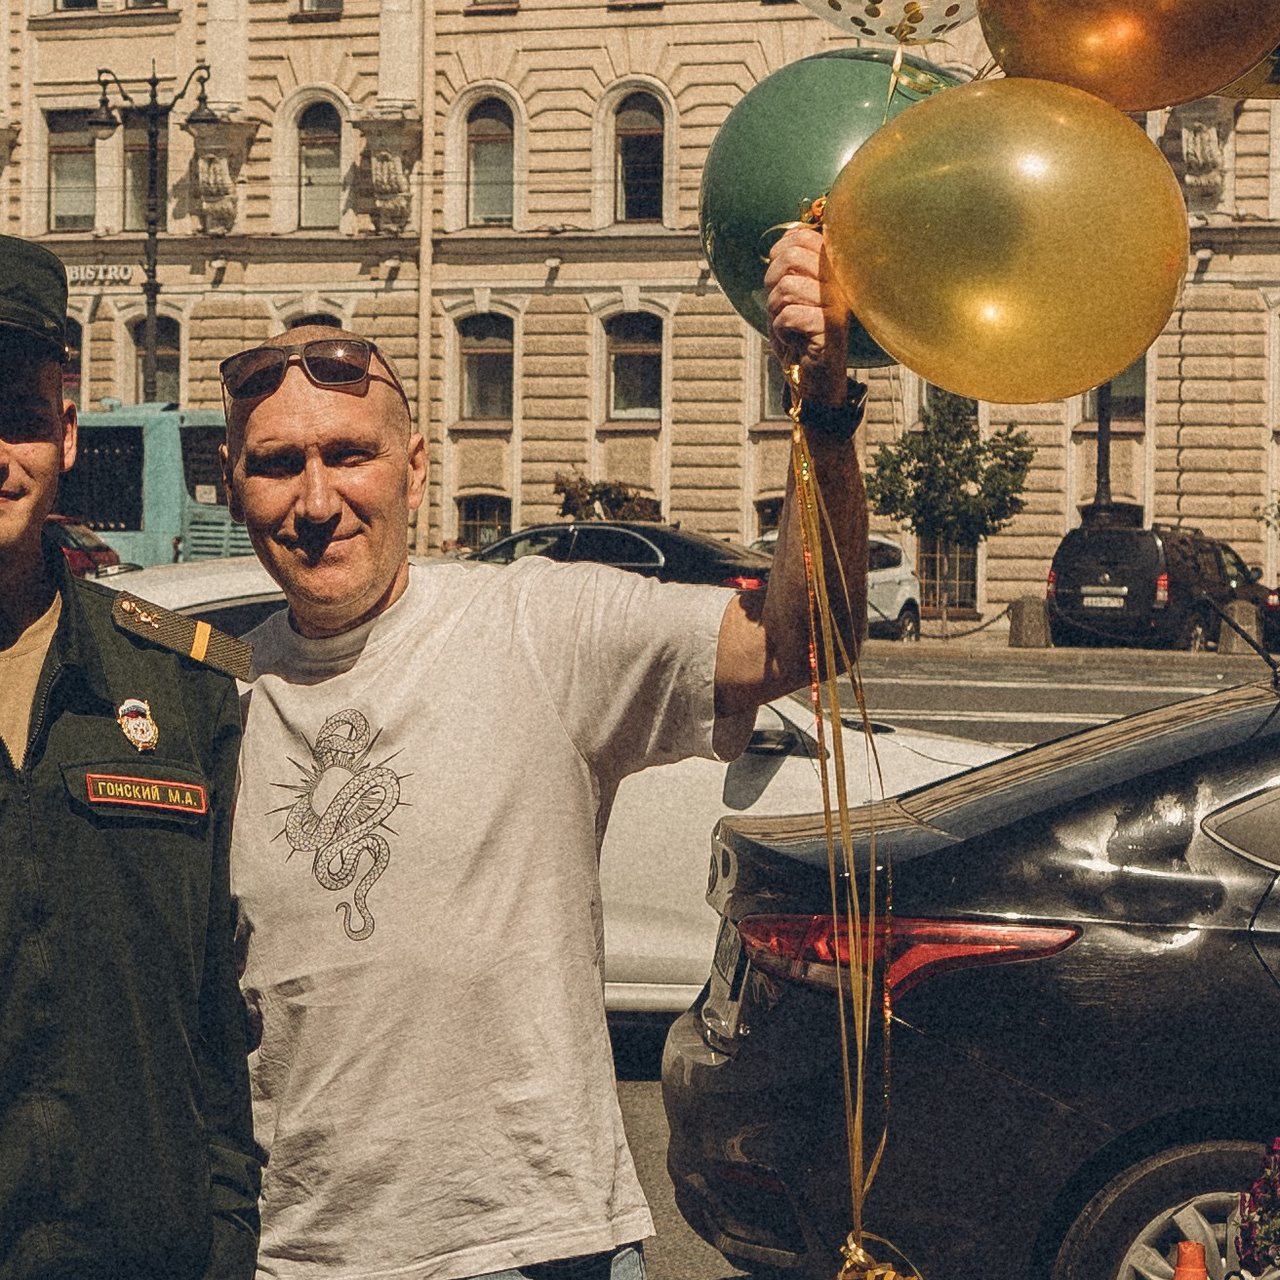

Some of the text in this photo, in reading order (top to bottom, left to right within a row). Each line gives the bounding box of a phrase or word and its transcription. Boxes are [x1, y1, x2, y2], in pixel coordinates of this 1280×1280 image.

[69, 265, 133, 281] BISTRO
[98, 782, 198, 807] ГОНСКИЙ М.А.
